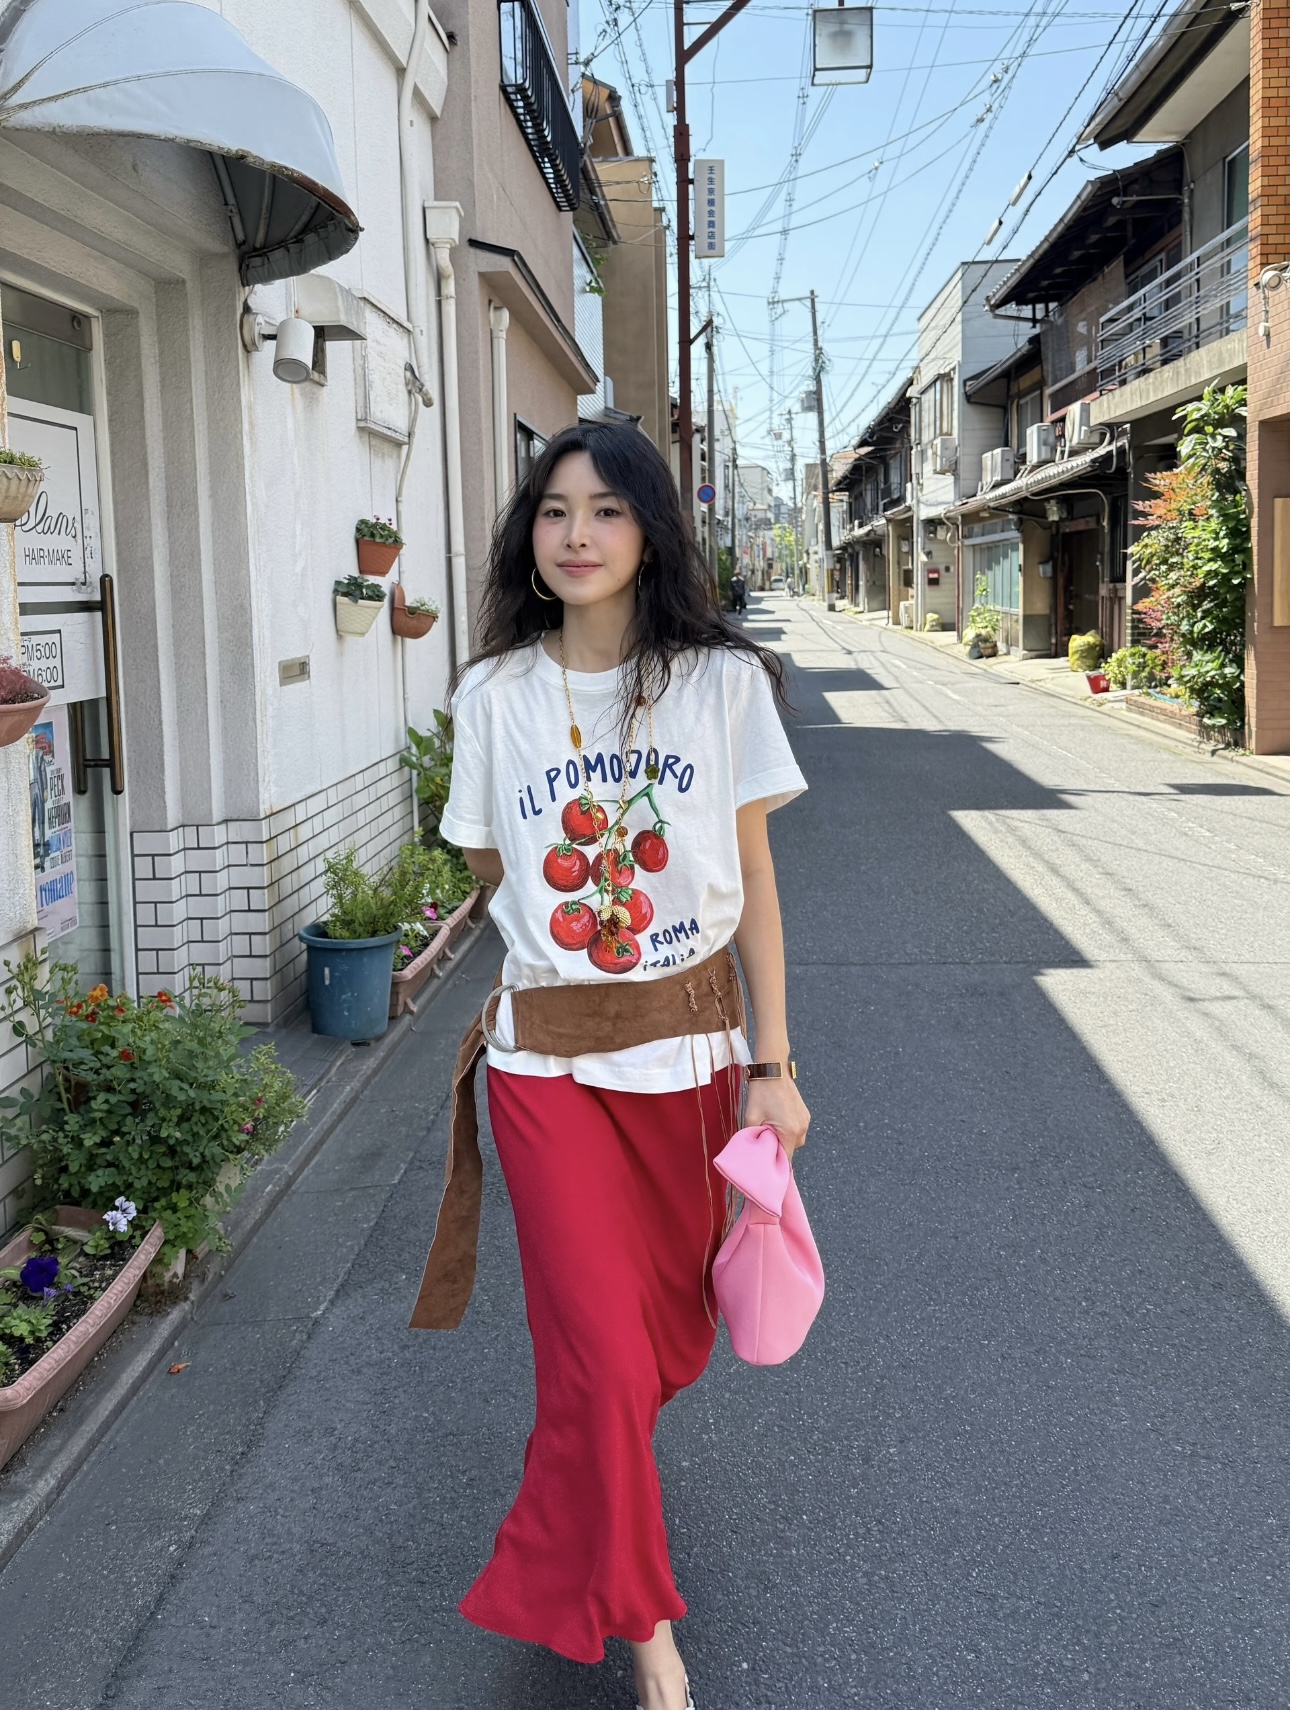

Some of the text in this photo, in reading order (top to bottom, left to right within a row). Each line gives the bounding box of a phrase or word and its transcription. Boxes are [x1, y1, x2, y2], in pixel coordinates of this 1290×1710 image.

[49, 772, 66, 800] PECK
[544, 747, 695, 803] POMODORO
[649, 917, 701, 952] ROMA
